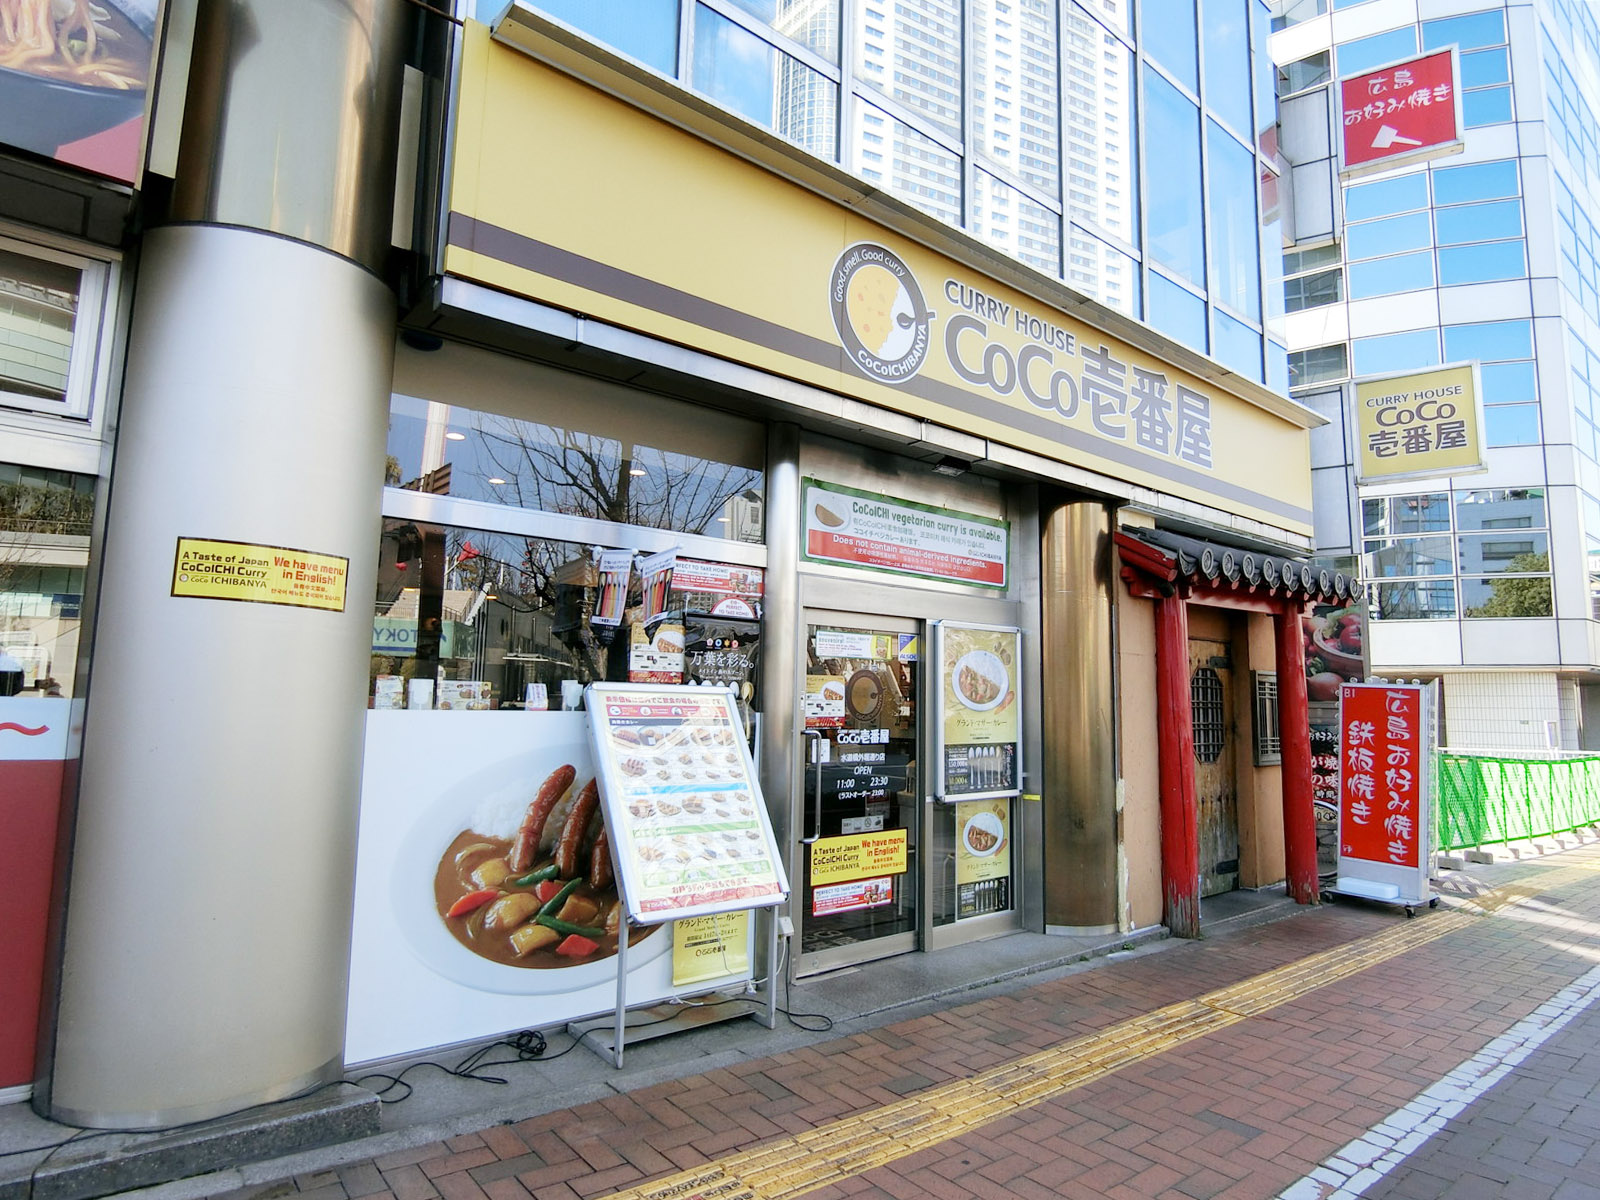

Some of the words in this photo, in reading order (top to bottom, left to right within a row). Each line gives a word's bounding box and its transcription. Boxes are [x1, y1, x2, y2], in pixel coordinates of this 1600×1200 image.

[1367, 69, 1414, 97] 広島
[1345, 84, 1451, 126] お好み焼き
[834, 270, 847, 303] Good
[861, 249, 884, 262] Good
[884, 257, 906, 277] curry
[944, 279, 1010, 327] CURRY
[1014, 310, 1075, 356] HOUSE
[857, 324, 927, 377] CoCoICHIBANYA
[1366, 393, 1409, 408] CURRY
[1413, 384, 1463, 402] HOUSE
[1375, 401, 1457, 428] CoCo
[1368, 420, 1468, 459] 壱番屋
[852, 501, 890, 520] CoCoICHI
[891, 512, 935, 529] vegetarian
[937, 521, 958, 535] curry
[960, 525, 967, 535] is
[968, 527, 1003, 543] available.
[182, 551, 190, 560] A
[192, 552, 222, 562] Taste
[225, 555, 236, 563] of
[238, 556, 269, 567] Japan
[833, 534, 854, 546] Does
[855, 537, 869, 548] not
[870, 540, 898, 553] contain
[898, 545, 949, 562] animal-derived
[950, 555, 987, 569] ingredients.
[181, 562, 235, 574] CoCoICHI
[237, 567, 268, 578] Curry
[274, 556, 290, 568] We
[293, 559, 318, 572] have
[320, 564, 344, 576] menu
[211, 576, 267, 589] ICHIBANYA
[282, 569, 293, 579] in
[295, 571, 337, 585] English!
[690, 650, 755, 669] 万葉を彩る。
[853, 765, 873, 775] OPEN
[1347, 720, 1376, 825] 鉄板焼き
[1384, 689, 1412, 864] 広島お好み焼き
[836, 778, 855, 789] 11:00
[869, 776, 889, 787] 23:30
[813, 848, 818, 856] A
[818, 846, 836, 855] Taste
[843, 844, 860, 852] Japan
[862, 839, 871, 848] We
[872, 838, 888, 847] have
[887, 837, 905, 845] menu
[866, 849, 873, 857] in
[873, 845, 900, 856] English!
[830, 862, 860, 873] ICHIBANYA
[843, 854, 859, 862] Curry
